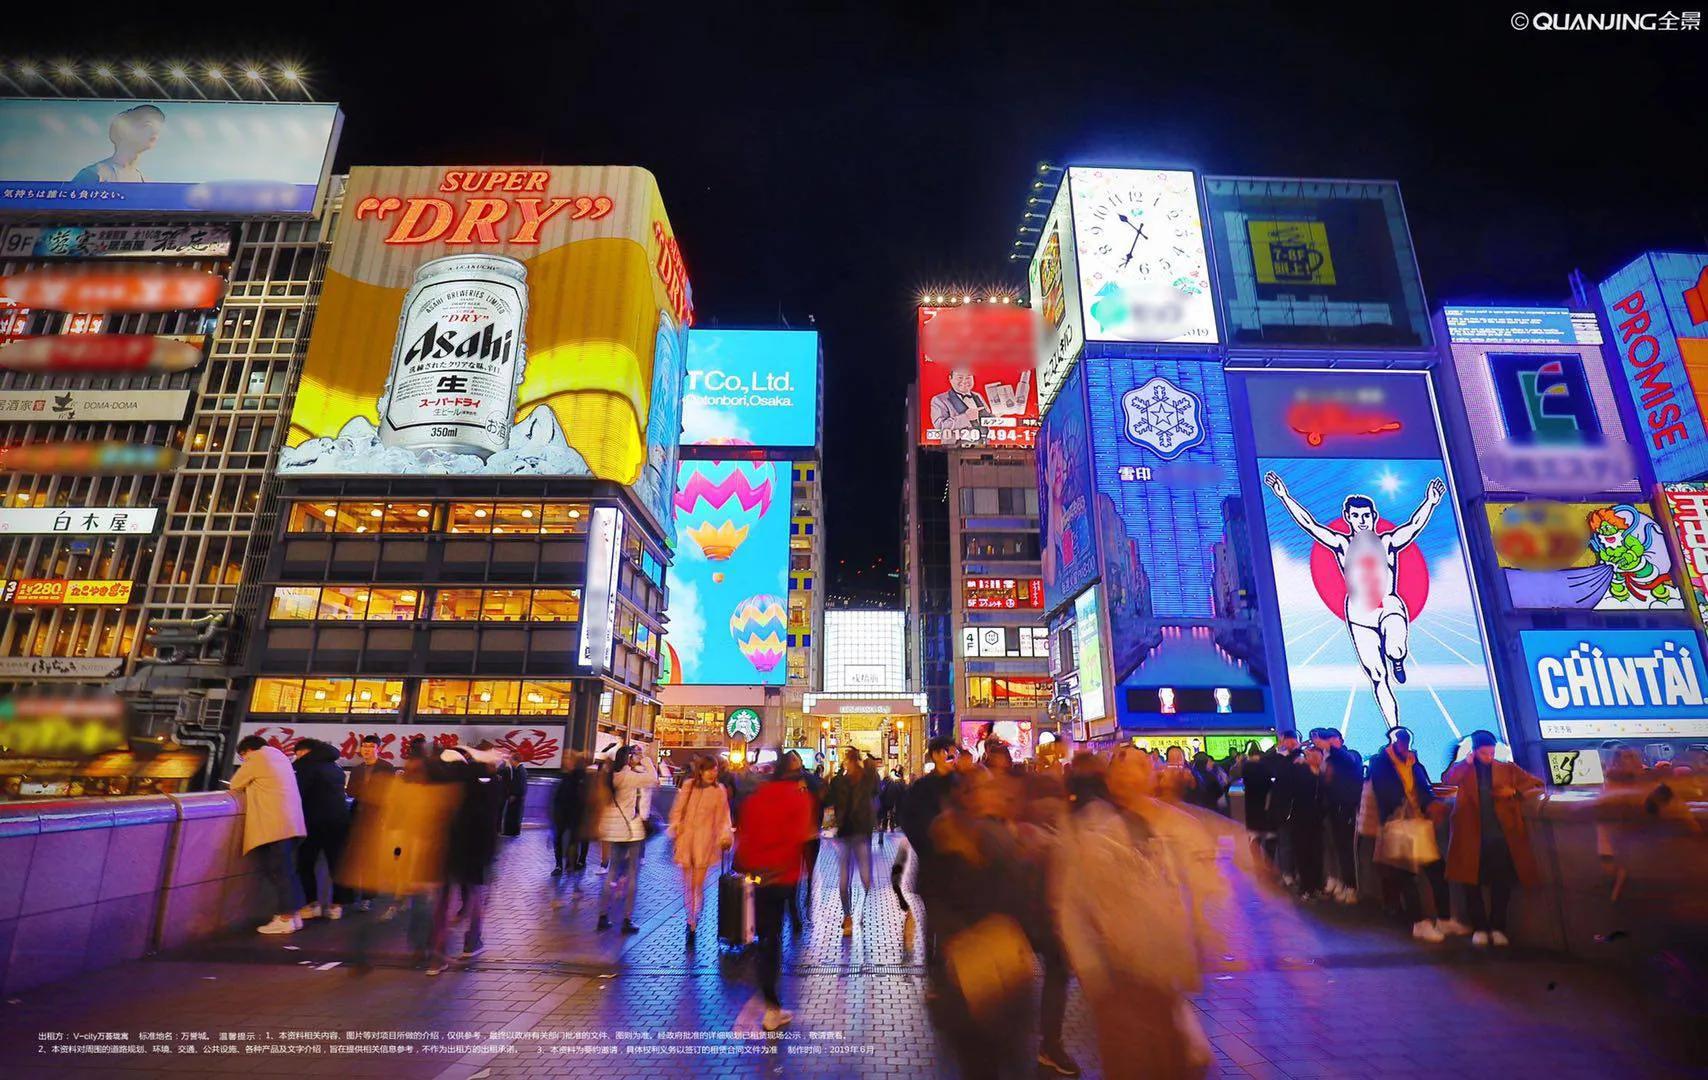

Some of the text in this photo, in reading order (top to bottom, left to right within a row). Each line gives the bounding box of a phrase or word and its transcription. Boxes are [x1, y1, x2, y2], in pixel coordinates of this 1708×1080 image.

[440, 170, 549, 193] SUPER
[7, 234, 32, 251] 9F
[404, 322, 512, 366] Asahi
[1612, 289, 1689, 452] PROMISE
[436, 375, 468, 393] 生
[419, 398, 481, 408] スーパードライ
[431, 427, 458, 437] 350ml
[1118, 466, 1151, 482] 雪印
[53, 510, 129, 532] 白木屋
